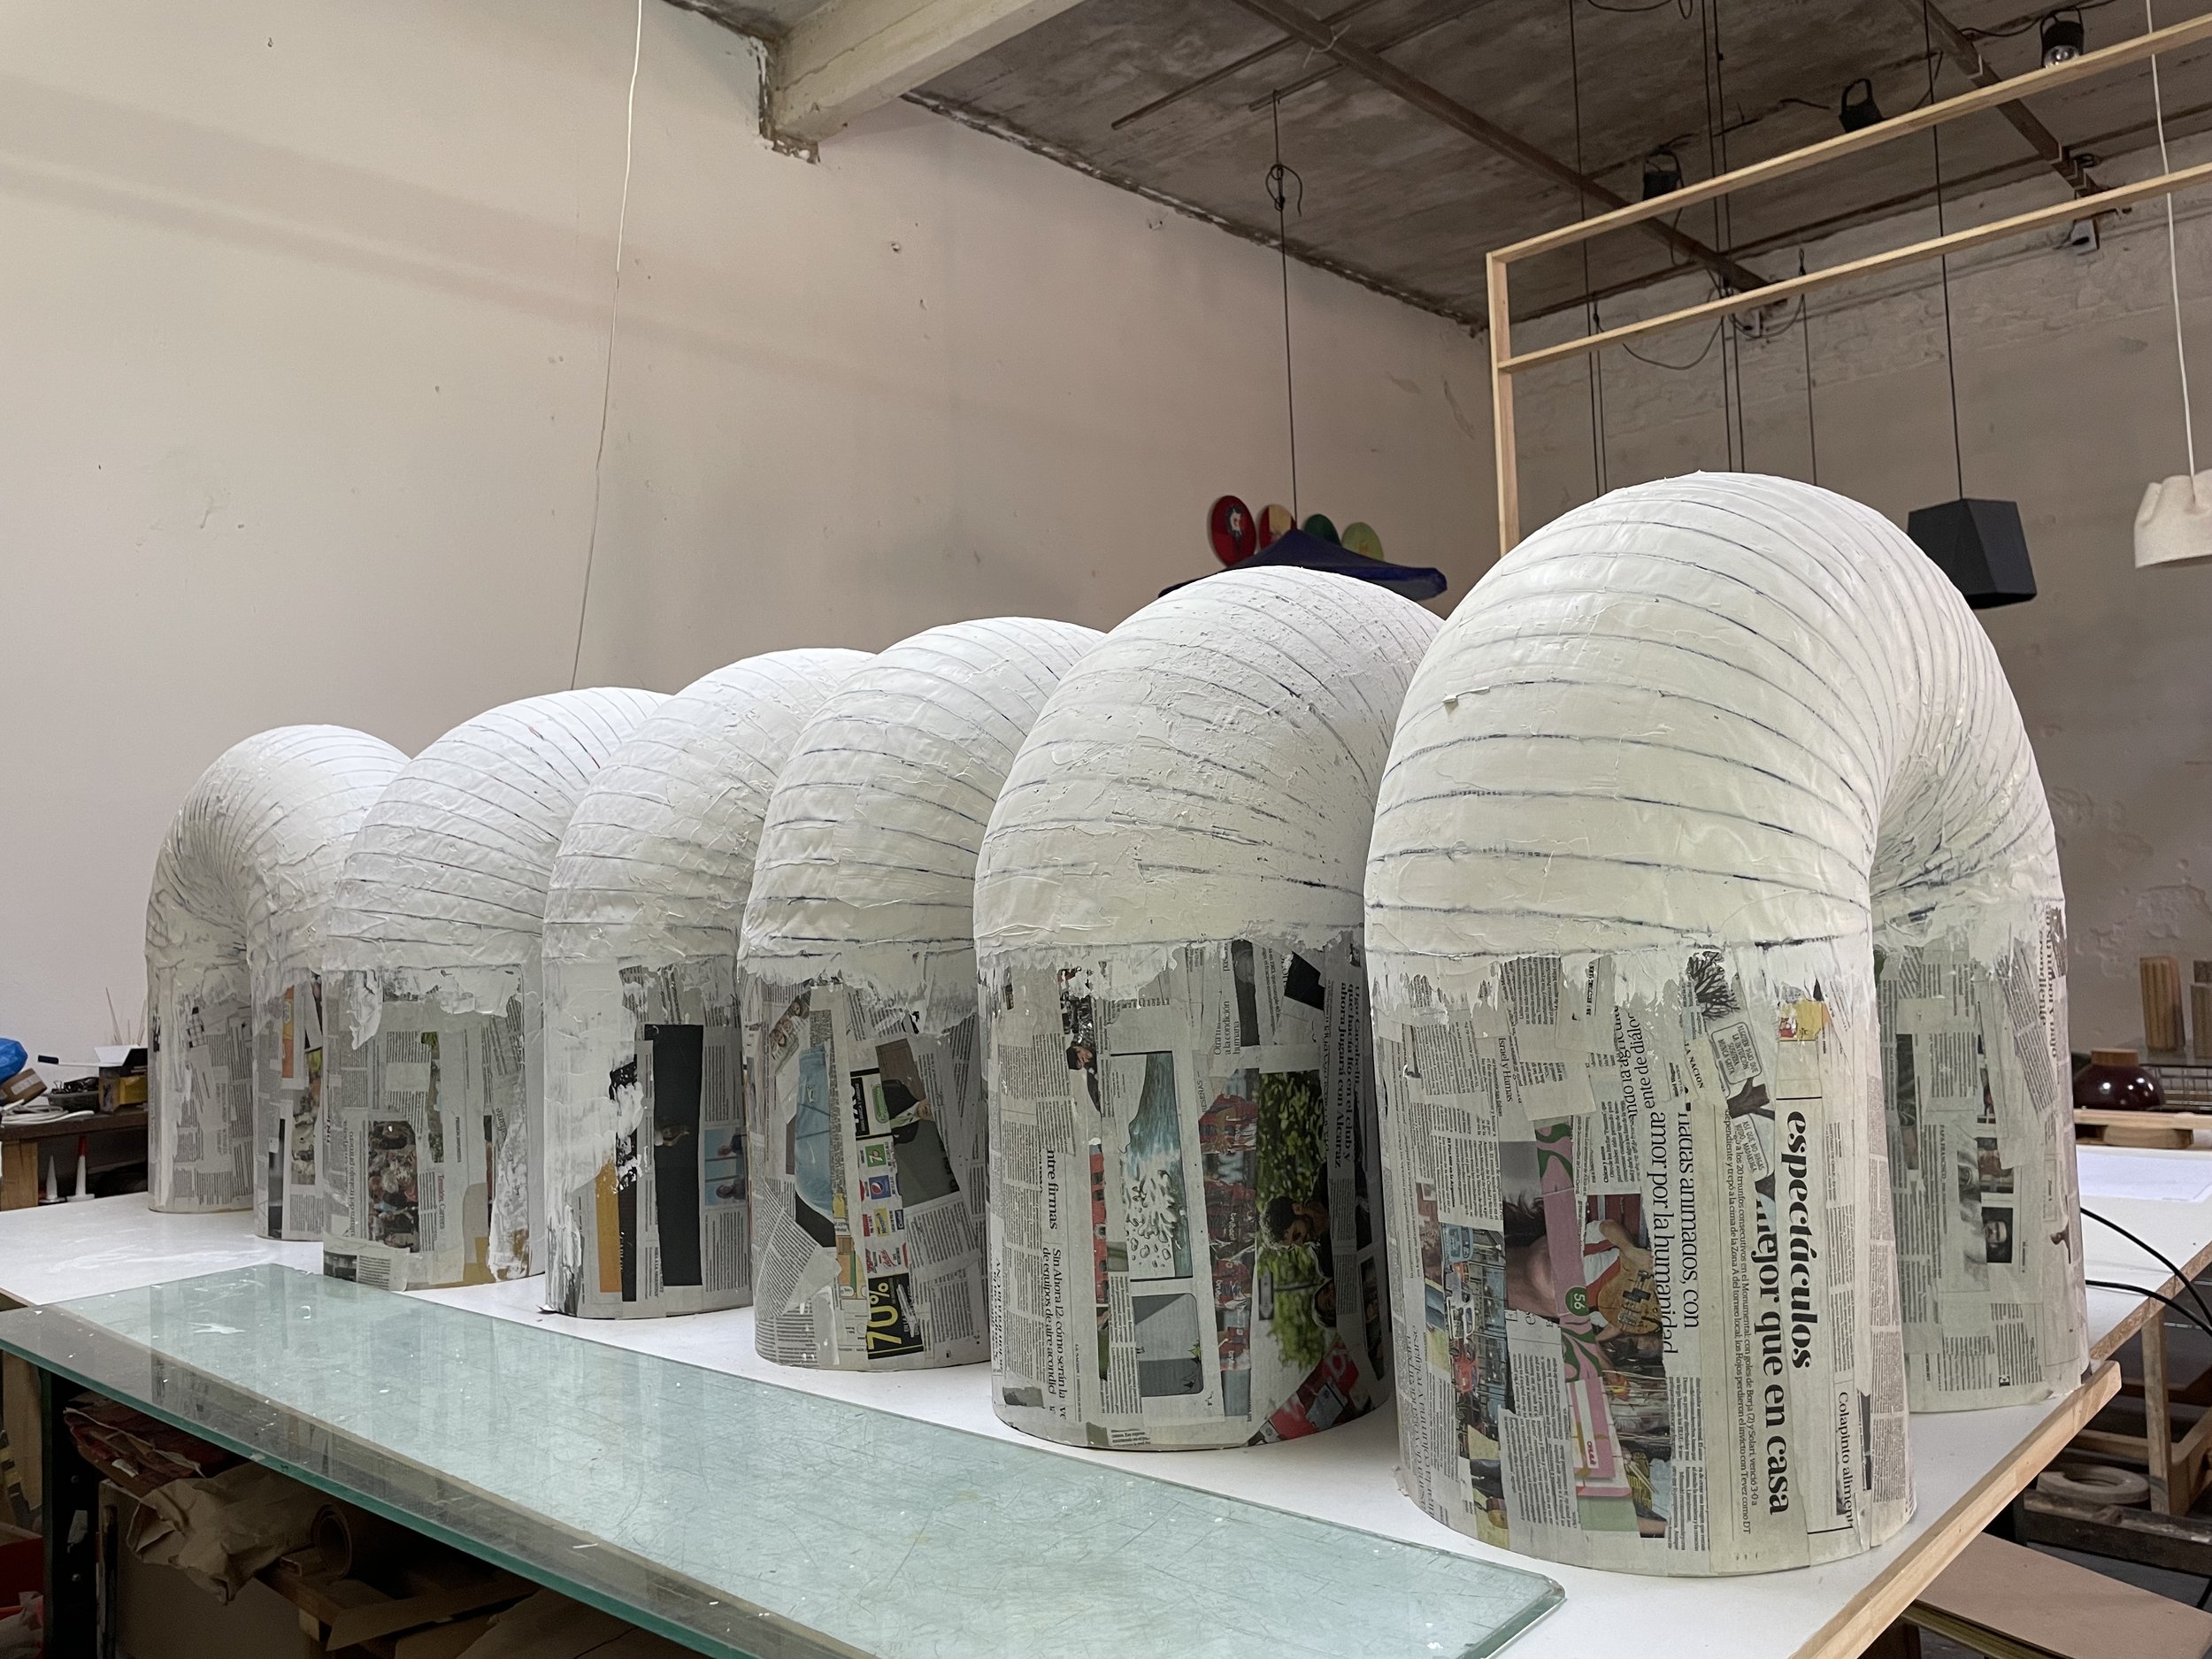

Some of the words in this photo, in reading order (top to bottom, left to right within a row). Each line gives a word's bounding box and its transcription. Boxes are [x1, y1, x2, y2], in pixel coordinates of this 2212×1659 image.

[1222, 1000, 1232, 1041] condición
[1732, 1033, 1740, 1043] LA
[1737, 1025, 1748, 1048] ALGUIEN
[1497, 1037, 1509, 1062] Israel
[1717, 1039, 1728, 1059] NUNCA
[1724, 1059, 1735, 1076] GRITA
[1742, 1049, 1753, 1061] DIJO
[1634, 1056, 1649, 1075] de
[1688, 1056, 1705, 1089] NACION
[1748, 1062, 1759, 1073] QUE
[1346, 1079, 1352, 1096] en
[1502, 1070, 1514, 1103] Hamas
[1640, 1077, 1655, 1109] ente
[1345, 1100, 1353, 1113] el
[1334, 1108, 1345, 1169] Alcaraz
[1344, 1116, 1353, 1149] club
[1649, 1112, 1667, 1170] amor
[1745, 1132, 1755, 1143] QUE
[1735, 1152, 1744, 1163] los
[1748, 1143, 1757, 1153] NO
[1736, 1164, 1744, 1175] 20
[1752, 1154, 1764, 1171] HAGAS
[1647, 1171, 1670, 1209] por
[1725, 1168, 1736, 1191] trepó
[1737, 1176, 1747, 1209] triunfos
[1048, 1182, 1059, 1230] firmas
[1653, 1212, 1674, 1231] la
[1730, 1227, 1738, 1237] de
[1738, 1210, 1748, 1262] consecutivos
[1781, 1111, 1817, 1369] espectáculos
[1042, 1247, 1051, 1262] de
[1052, 1248, 1062, 1267] Sin
[1740, 1263, 1747, 1273] en
[1041, 1263, 1055, 1308] equipos
[1054, 1269, 1063, 1303] Ahora
[1654, 1233, 1678, 1354] humanidad
[1573, 1293, 1585, 1310] 56
[1683, 1289, 1700, 1329] con
[1741, 1283, 1751, 1337] Monumental:
[867, 1282, 902, 1350] 70%
[1045, 1308, 1053, 1323] de
[1733, 1317, 1742, 1339] local;
[1046, 1324, 1056, 1347] aire
[1056, 1321, 1065, 1356] cómo
[1754, 1311, 1783, 1376] que
[1411, 1325, 1424, 1386] relajarse
[1734, 1353, 1744, 1376] Rojos
[1743, 1356, 1752, 1377] goles
[1057, 1356, 1067, 1387] serán
[1746, 1378, 1754, 1388] de
[1058, 1388, 1067, 1400] la
[1735, 1376, 1747, 1417] perdieron
[1745, 1389, 1755, 1411] Borja
[1765, 1385, 1786, 1428] en
[1747, 1413, 1755, 1424] (2)
[1838, 1391, 1851, 1463] Colapinto
[1419, 1401, 1431, 1468] columna
[1739, 1426, 1748, 1455] invicto
[1747, 1431, 1756, 1456] Solari,
[1740, 1472, 1750, 1496] Tevez
[1749, 1458, 1758, 1486] venció
[1767, 1435, 1790, 1515] casa
[1742, 1521, 1751, 1534] DT
